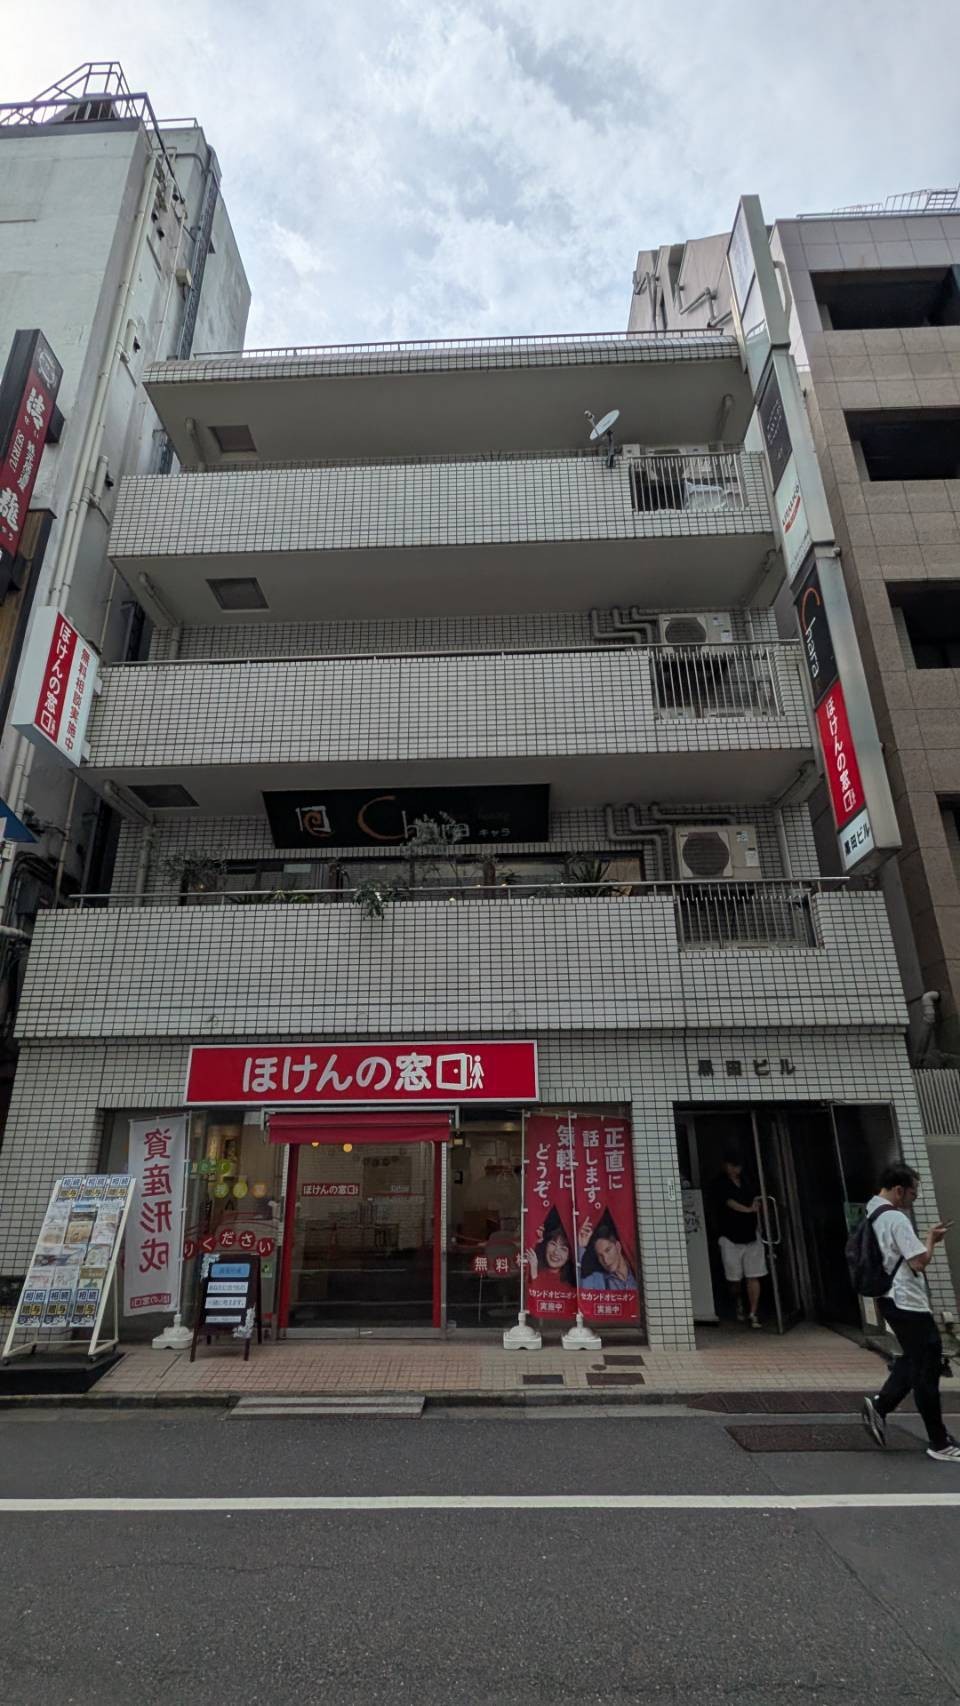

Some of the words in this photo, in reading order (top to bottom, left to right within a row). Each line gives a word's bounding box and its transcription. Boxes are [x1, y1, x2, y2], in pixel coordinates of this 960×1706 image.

[801, 588, 822, 678] Chara
[41, 621, 72, 733] ほけんの窓口
[825, 696, 857, 812] ほけんの窓口
[242, 1052, 474, 1092] ほけんの窓口
[533, 1143, 552, 1208] どうぞ。
[556, 1124, 576, 1189] 気軽に
[582, 1129, 601, 1210] 話します。
[604, 1127, 625, 1190] 正直に
[303, 1185, 358, 1195] ほけんの窓口
[184, 1232, 271, 1257] りください
[581, 1292, 634, 1302] セカンドオピニオン
